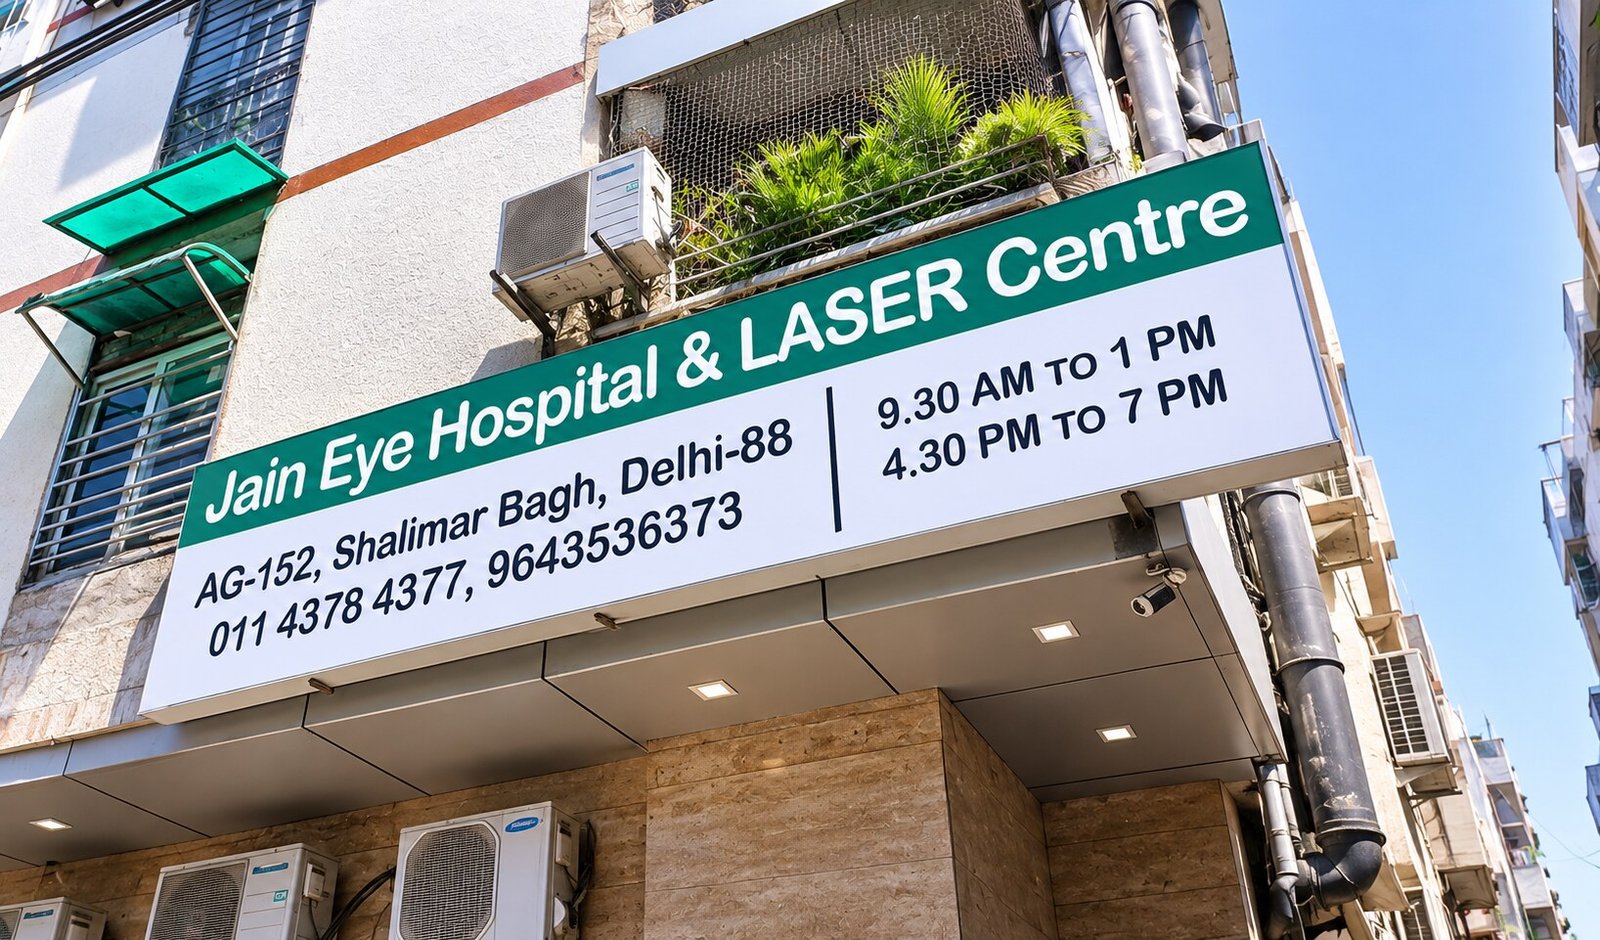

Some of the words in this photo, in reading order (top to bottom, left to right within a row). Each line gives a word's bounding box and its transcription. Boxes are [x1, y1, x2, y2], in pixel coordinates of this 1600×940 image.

[204, 455, 308, 525] Jain
[318, 432, 415, 497] Eye
[428, 344, 659, 461] Hospital
[676, 330, 724, 389] &
[740, 256, 968, 373] LASER
[986, 188, 1250, 298] Centre
[877, 381, 960, 430] 9.30
[971, 360, 1035, 407] AM
[1044, 352, 1098, 386] TO
[1109, 336, 1131, 369] 1
[1146, 314, 1216, 362] PM
[882, 432, 966, 481] 4.30
[978, 413, 1042, 460] PM
[1051, 405, 1106, 440] TO
[1118, 387, 1143, 424] 7
[1157, 367, 1228, 417] PM
[194, 545, 321, 609] AG-152,
[332, 506, 489, 571] Shalimar
[498, 471, 607, 528] Bagh,
[621, 418, 793, 496] Delhi-88
[209, 610, 267, 657] 011
[276, 586, 364, 639] 4378
[371, 559, 474, 616] 4377,
[487, 490, 743, 589] 9643536373
